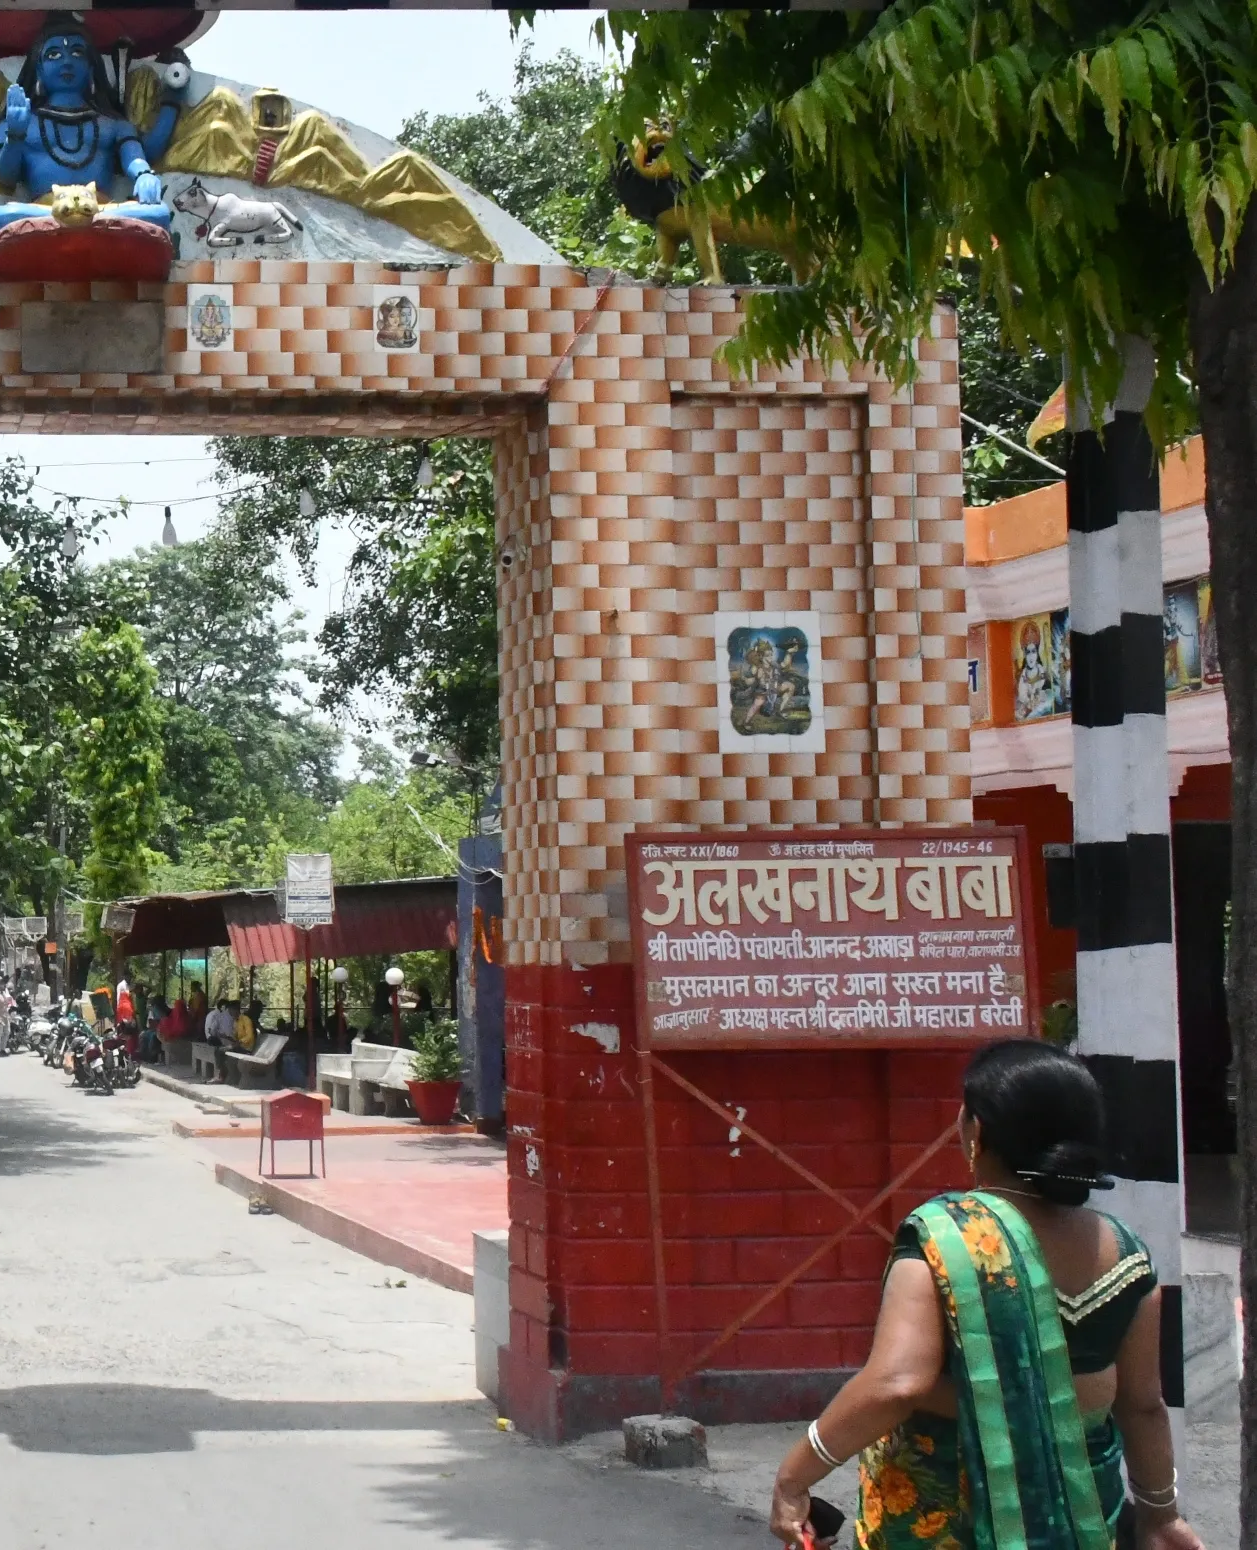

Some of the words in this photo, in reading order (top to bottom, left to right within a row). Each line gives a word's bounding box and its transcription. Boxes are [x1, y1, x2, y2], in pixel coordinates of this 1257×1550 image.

[642, 859, 901, 926] अलखनाथ
[903, 856, 1013, 919] बाबा
[648, 931, 668, 962] श्री
[669, 930, 741, 961] तापोनिधि
[662, 975, 750, 1006] मुसलमान
[753, 975, 778, 998] का
[781, 974, 839, 1000] अन्दर
[842, 973, 887, 996] आना
[944, 971, 985, 995] मना
[987, 963, 1006, 996] है
[719, 1007, 768, 1031] अध्यक्ष
[770, 1007, 807, 1030] महन्त
[808, 999, 827, 1029] श्री
[889, 997, 912, 1028] जी
[913, 1005, 976, 1029] महाराज
[979, 996, 1024, 1027] बरेली
